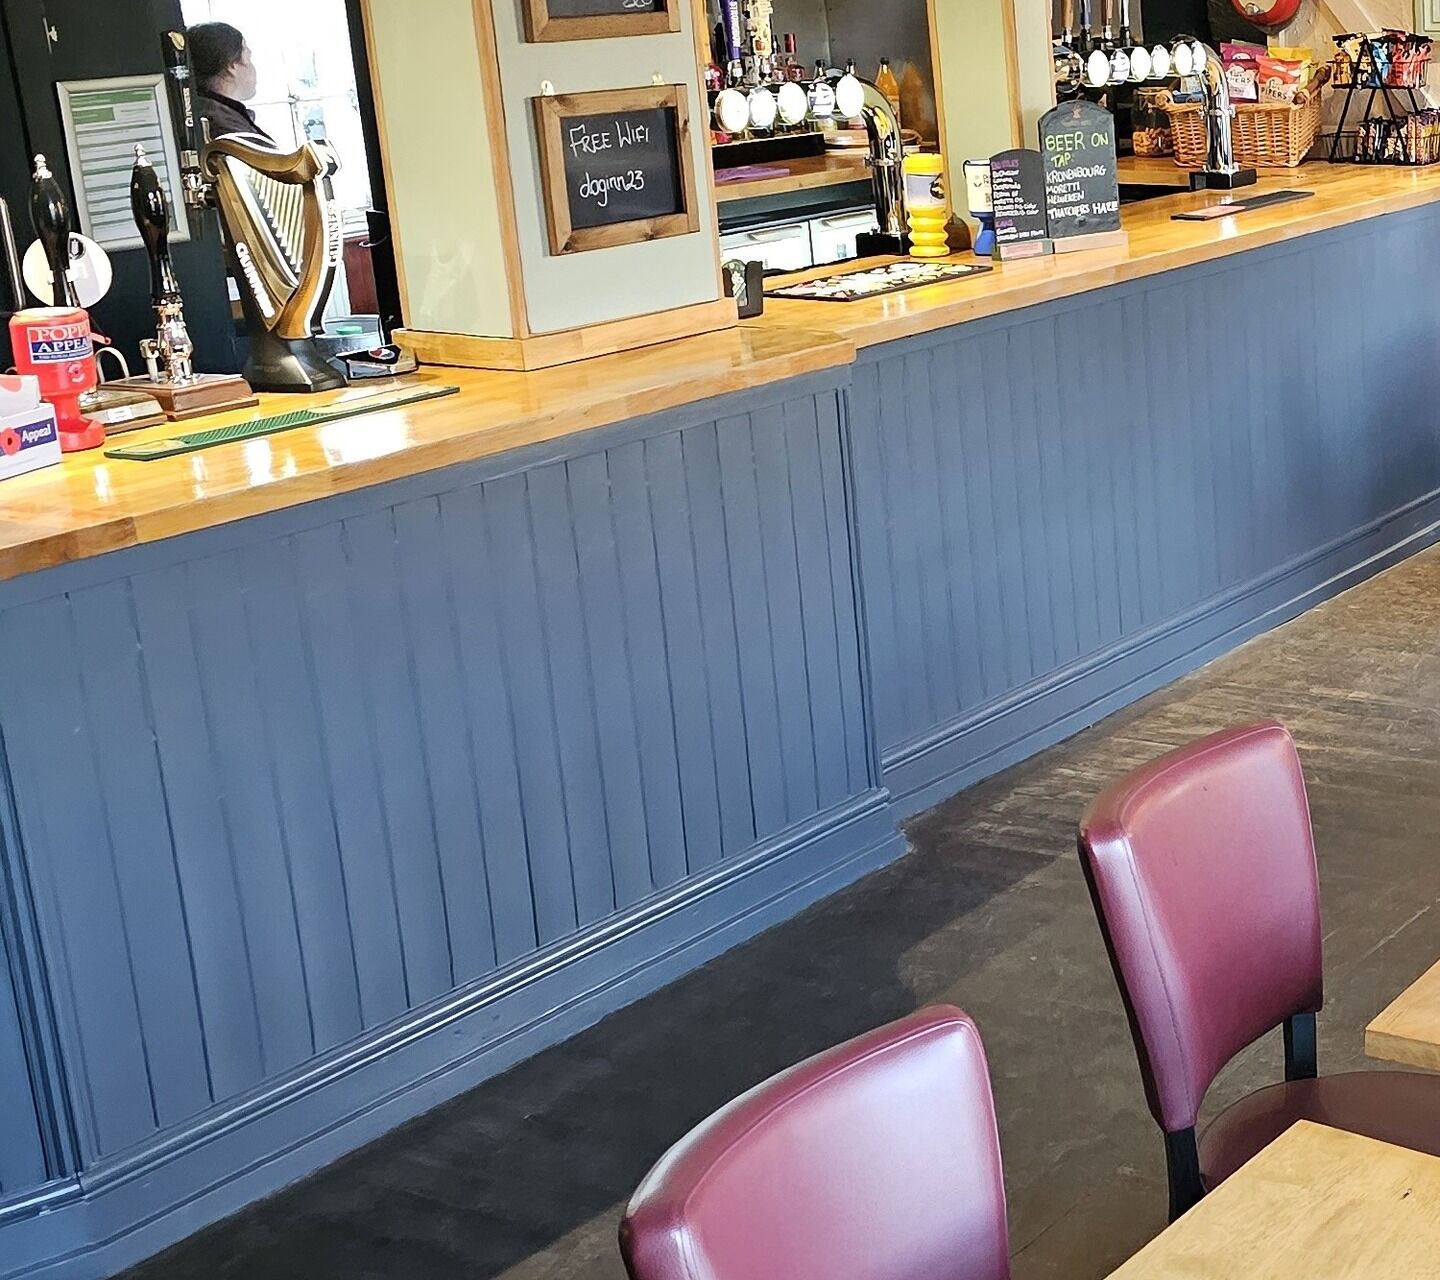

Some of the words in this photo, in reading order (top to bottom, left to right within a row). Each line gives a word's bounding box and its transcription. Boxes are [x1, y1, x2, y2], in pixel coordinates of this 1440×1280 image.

[569, 123, 612, 158] FREE
[1045, 131, 1086, 152] BEER
[1091, 132, 1109, 147] ON
[38, 338, 90, 353] APPEA
[22, 423, 51, 444] Appeal
